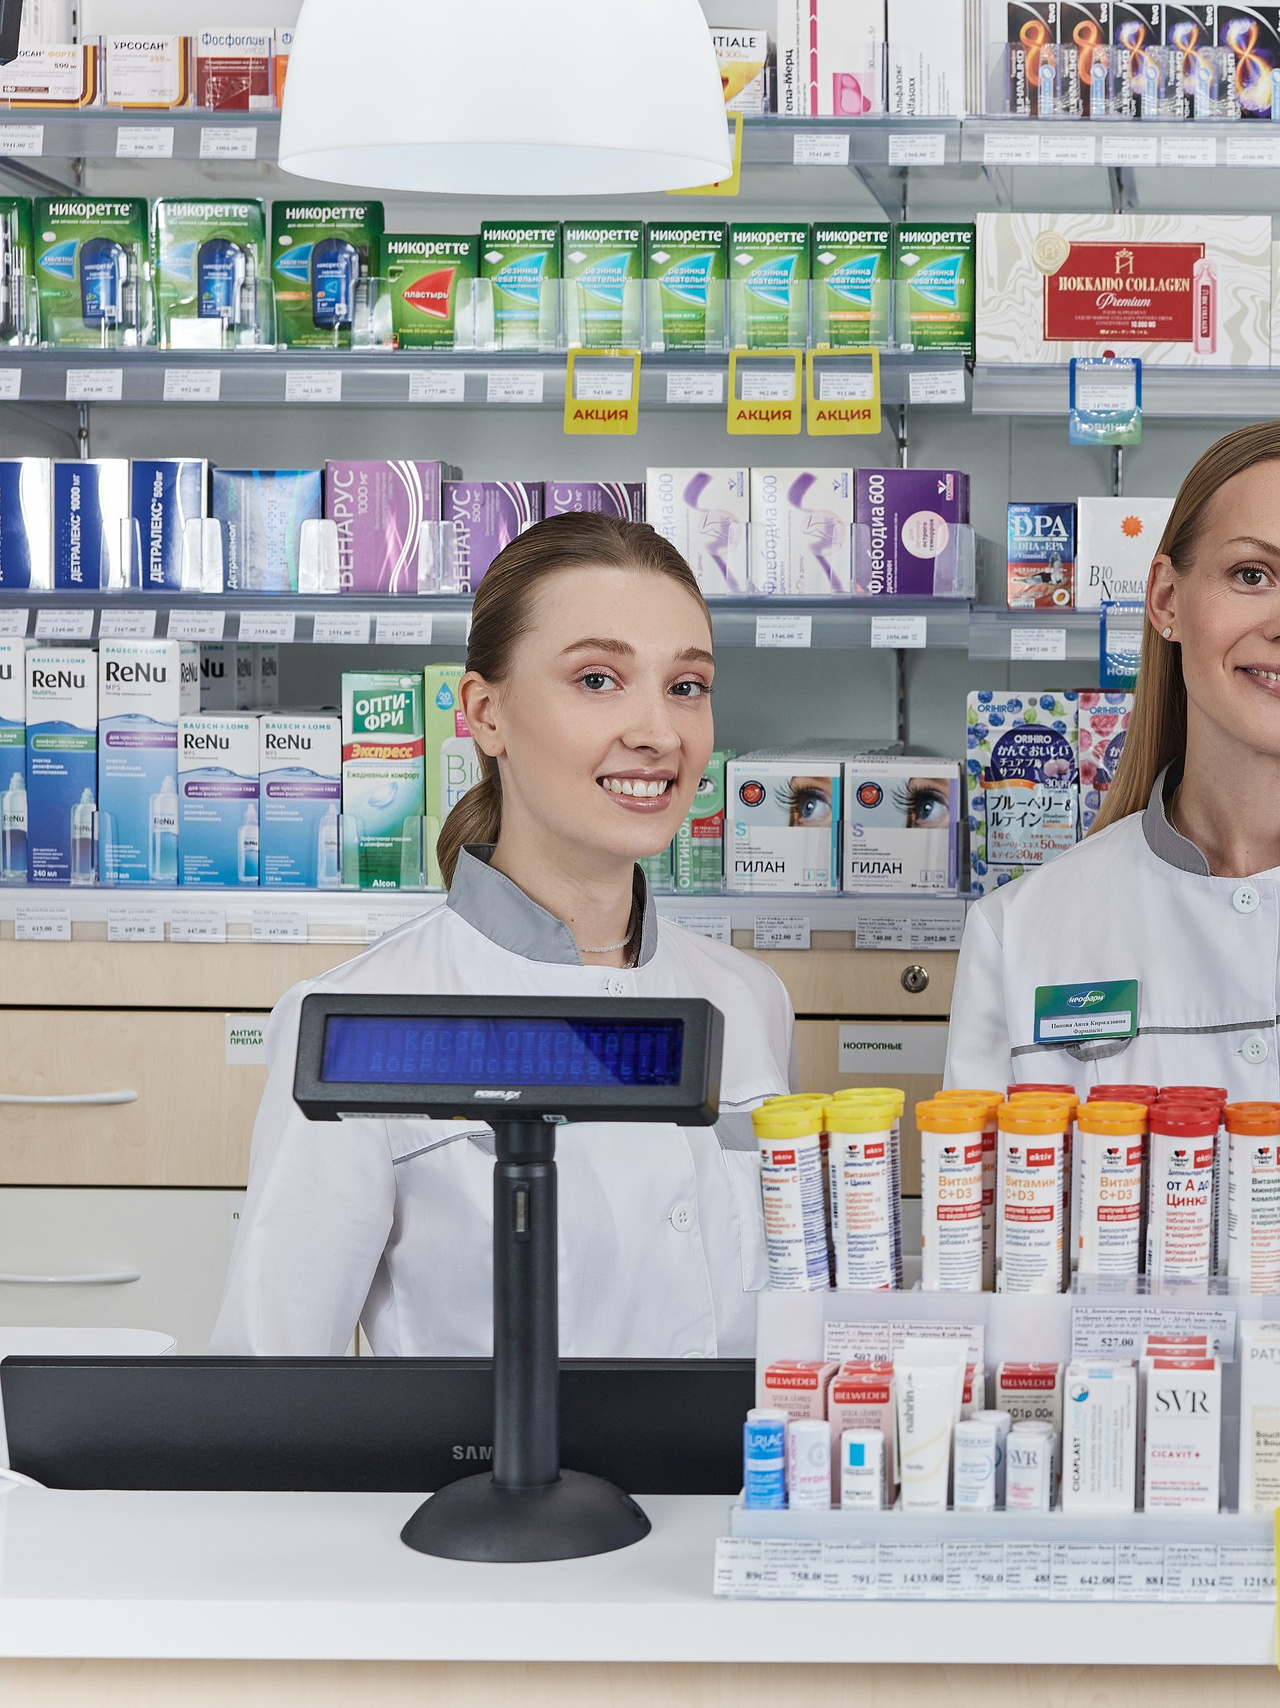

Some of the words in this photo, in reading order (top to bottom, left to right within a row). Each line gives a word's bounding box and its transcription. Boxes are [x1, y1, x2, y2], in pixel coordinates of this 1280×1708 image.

[114, 42, 164, 50] УРСОСАН
[49, 202, 129, 217] никоретте
[167, 202, 248, 218] никоретте
[286, 205, 364, 221] никоретте
[388, 241, 468, 255] никоретте
[1058, 277, 1123, 291] HOKKAIDO
[1126, 277, 1190, 291] COLLAGEN
[1096, 294, 1151, 309] Premium
[573, 409, 628, 420] АКЦИЯ
[736, 409, 792, 421] АКЦИЯ
[816, 409, 871, 421] АКЦИЯ
[1077, 423, 1135, 433] НОВИНКА
[870, 474, 885, 500] 600
[71, 485, 80, 511] 1000
[337, 471, 354, 589] ВЕНАРУС
[1013, 515, 1069, 537] DPA
[71, 513, 82, 582] ДЕТРАЛЕКС
[150, 501, 162, 583] ДЕТРАЛЕКС
[869, 504, 885, 594] Флебодиа
[32, 670, 85, 688] ReNu
[106, 661, 166, 682] ReNu
[355, 694, 410, 715] ОПТИ-
[364, 711, 403, 730] ФРИ
[183, 733, 229, 750] ReNu
[265, 733, 311, 750] ReNu
[1015, 734, 1051, 744] ORIHIRO
[351, 744, 412, 759] Экспресс
[998, 745, 1070, 758] かんでおいしい
[990, 810, 1041, 828] ルテイン
[735, 861, 785, 873] ГИЛАН
[851, 862, 902, 874] ГИЛАН
[372, 879, 396, 887] Alcon
[1051, 1021, 1074, 1029] Попова
[406, 1031, 485, 1049] КАССА
[505, 1032, 620, 1052] ОТКРЫТА
[843, 1041, 902, 1051] НООТРОПНЫЕ
[1006, 1176, 1055, 1188] Витамин
[1167, 1181, 1181, 1190] от
[1167, 1194, 1208, 1206] Цинка
[1101, 1338, 1134, 1346] 527.00
[766, 1377, 817, 1386] BELWEDER
[834, 1391, 888, 1400] BELWEDER
[1155, 1389, 1209, 1413] SVR
[1010, 1451, 1037, 1466] SVR
